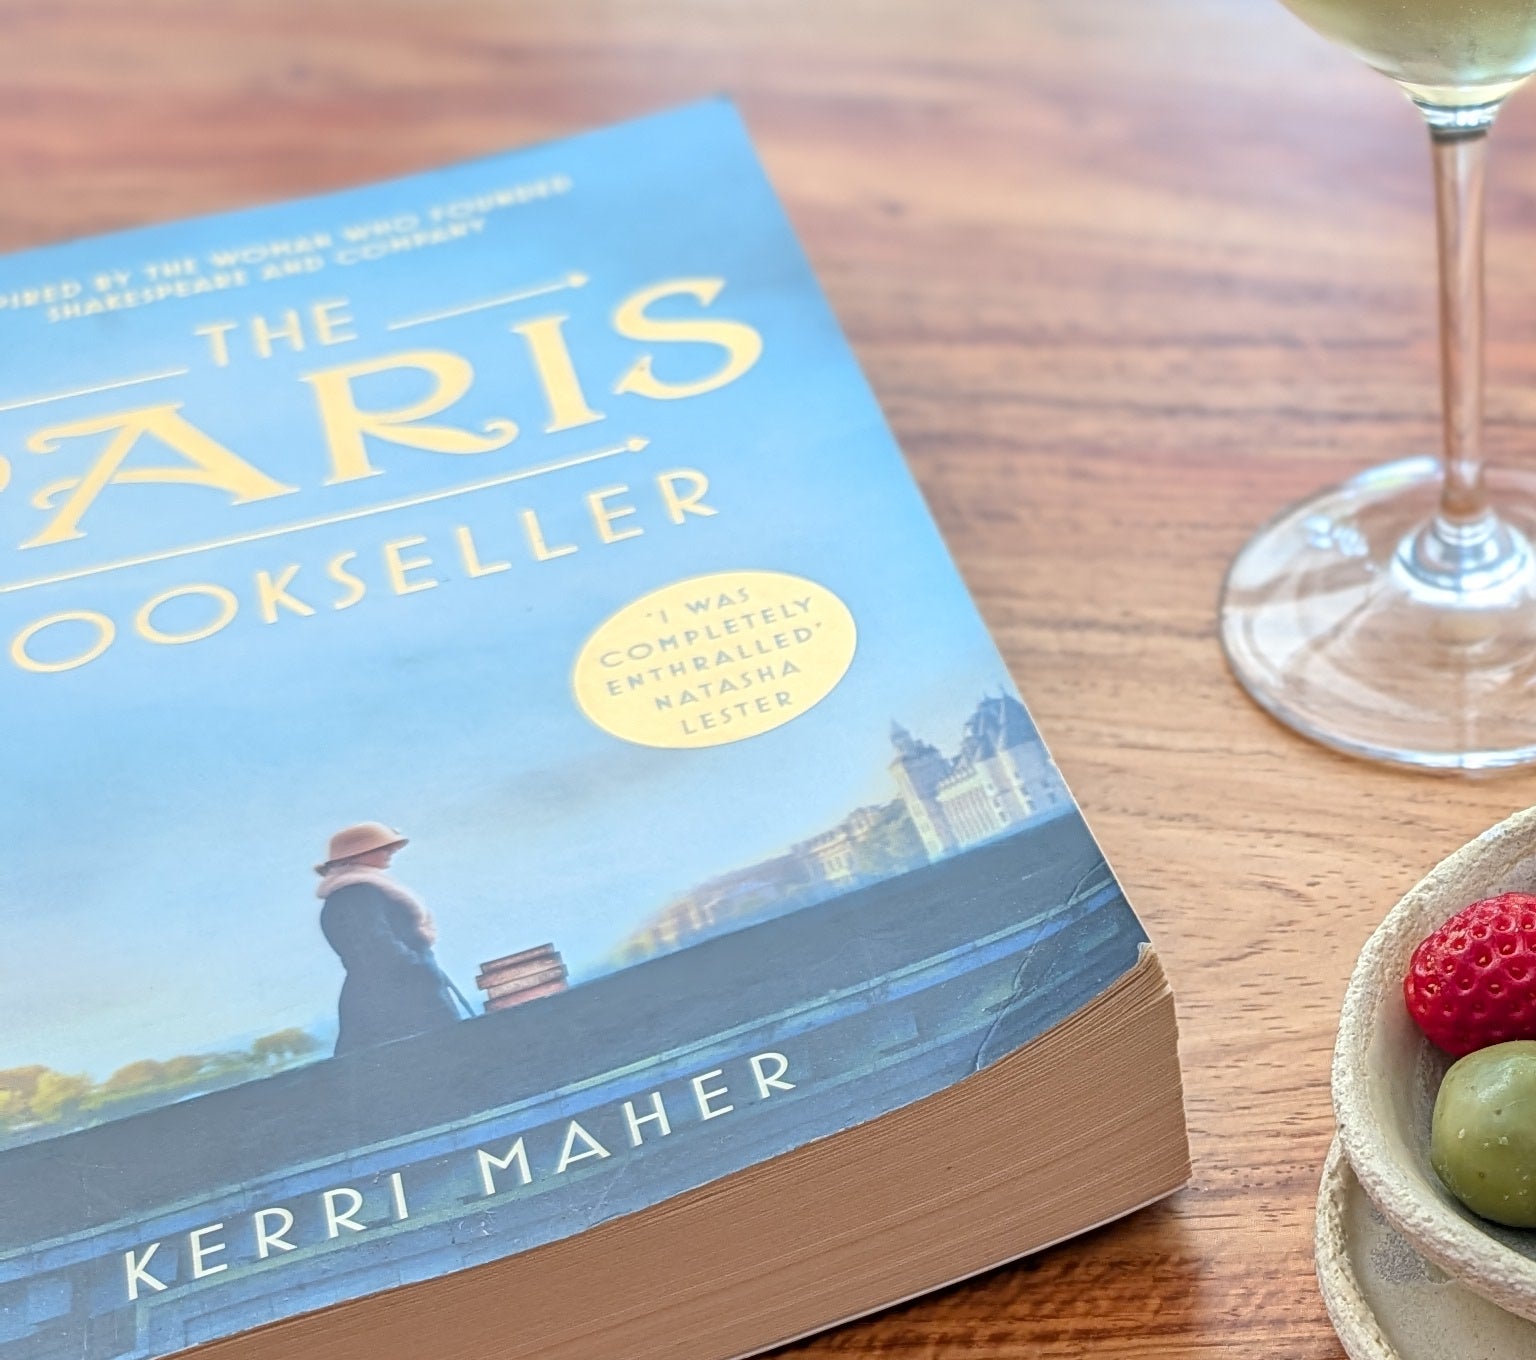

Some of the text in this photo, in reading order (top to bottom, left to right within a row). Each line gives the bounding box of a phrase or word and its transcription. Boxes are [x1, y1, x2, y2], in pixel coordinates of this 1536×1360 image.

[48, 217, 487, 323] SHAKESPEARE AND COMPANY
[93, 271, 130, 294] BY
[146, 257, 198, 281] THE
[211, 230, 333, 268] WOMAN
[343, 215, 419, 242] WHO
[429, 174, 573, 222] FOUNDED
[193, 299, 359, 367] THE
[0, 277, 764, 550] ARIS
[599, 596, 812, 668] COMPLETELY
[685, 587, 750, 615] WAS
[655, 658, 801, 711] NATASHA
[681, 690, 793, 735] LESTER
[124, 1051, 797, 1301] KERRI MAHER
